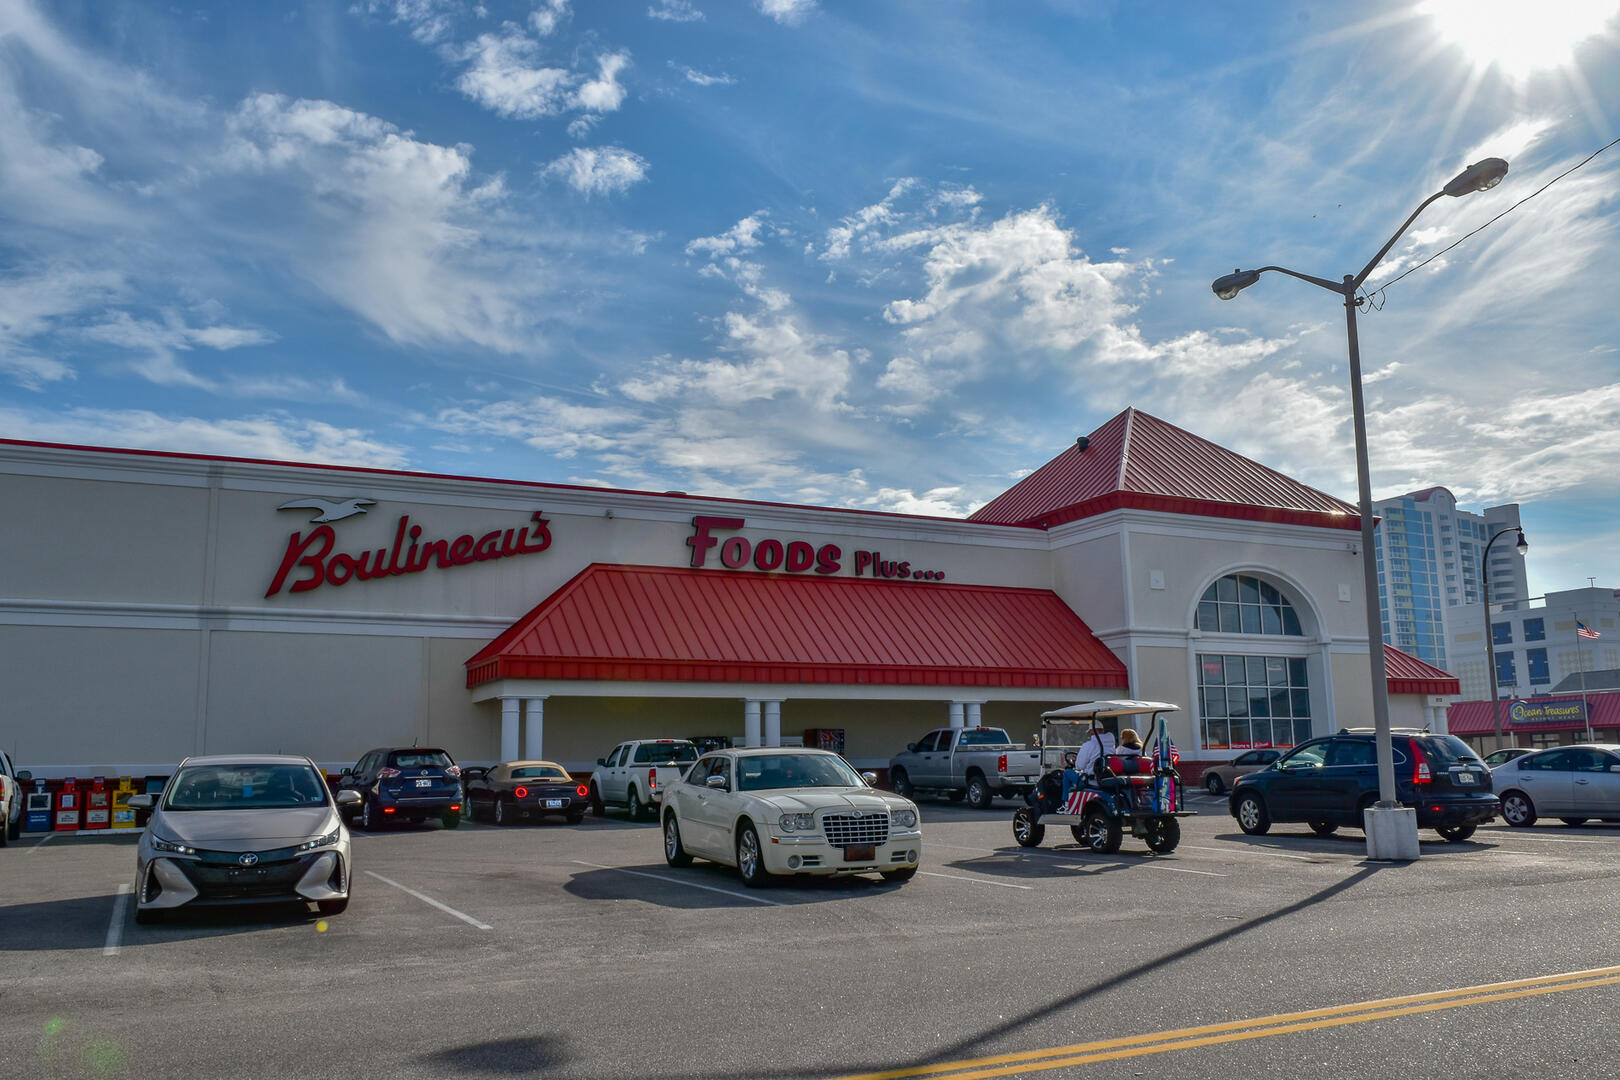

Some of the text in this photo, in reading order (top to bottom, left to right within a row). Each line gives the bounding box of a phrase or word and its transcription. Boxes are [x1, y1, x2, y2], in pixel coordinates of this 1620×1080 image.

[264, 510, 552, 599] Boulineau's
[687, 515, 945, 581] FOODS Plus...
[1513, 705, 1580, 721] Ocean Treasures
